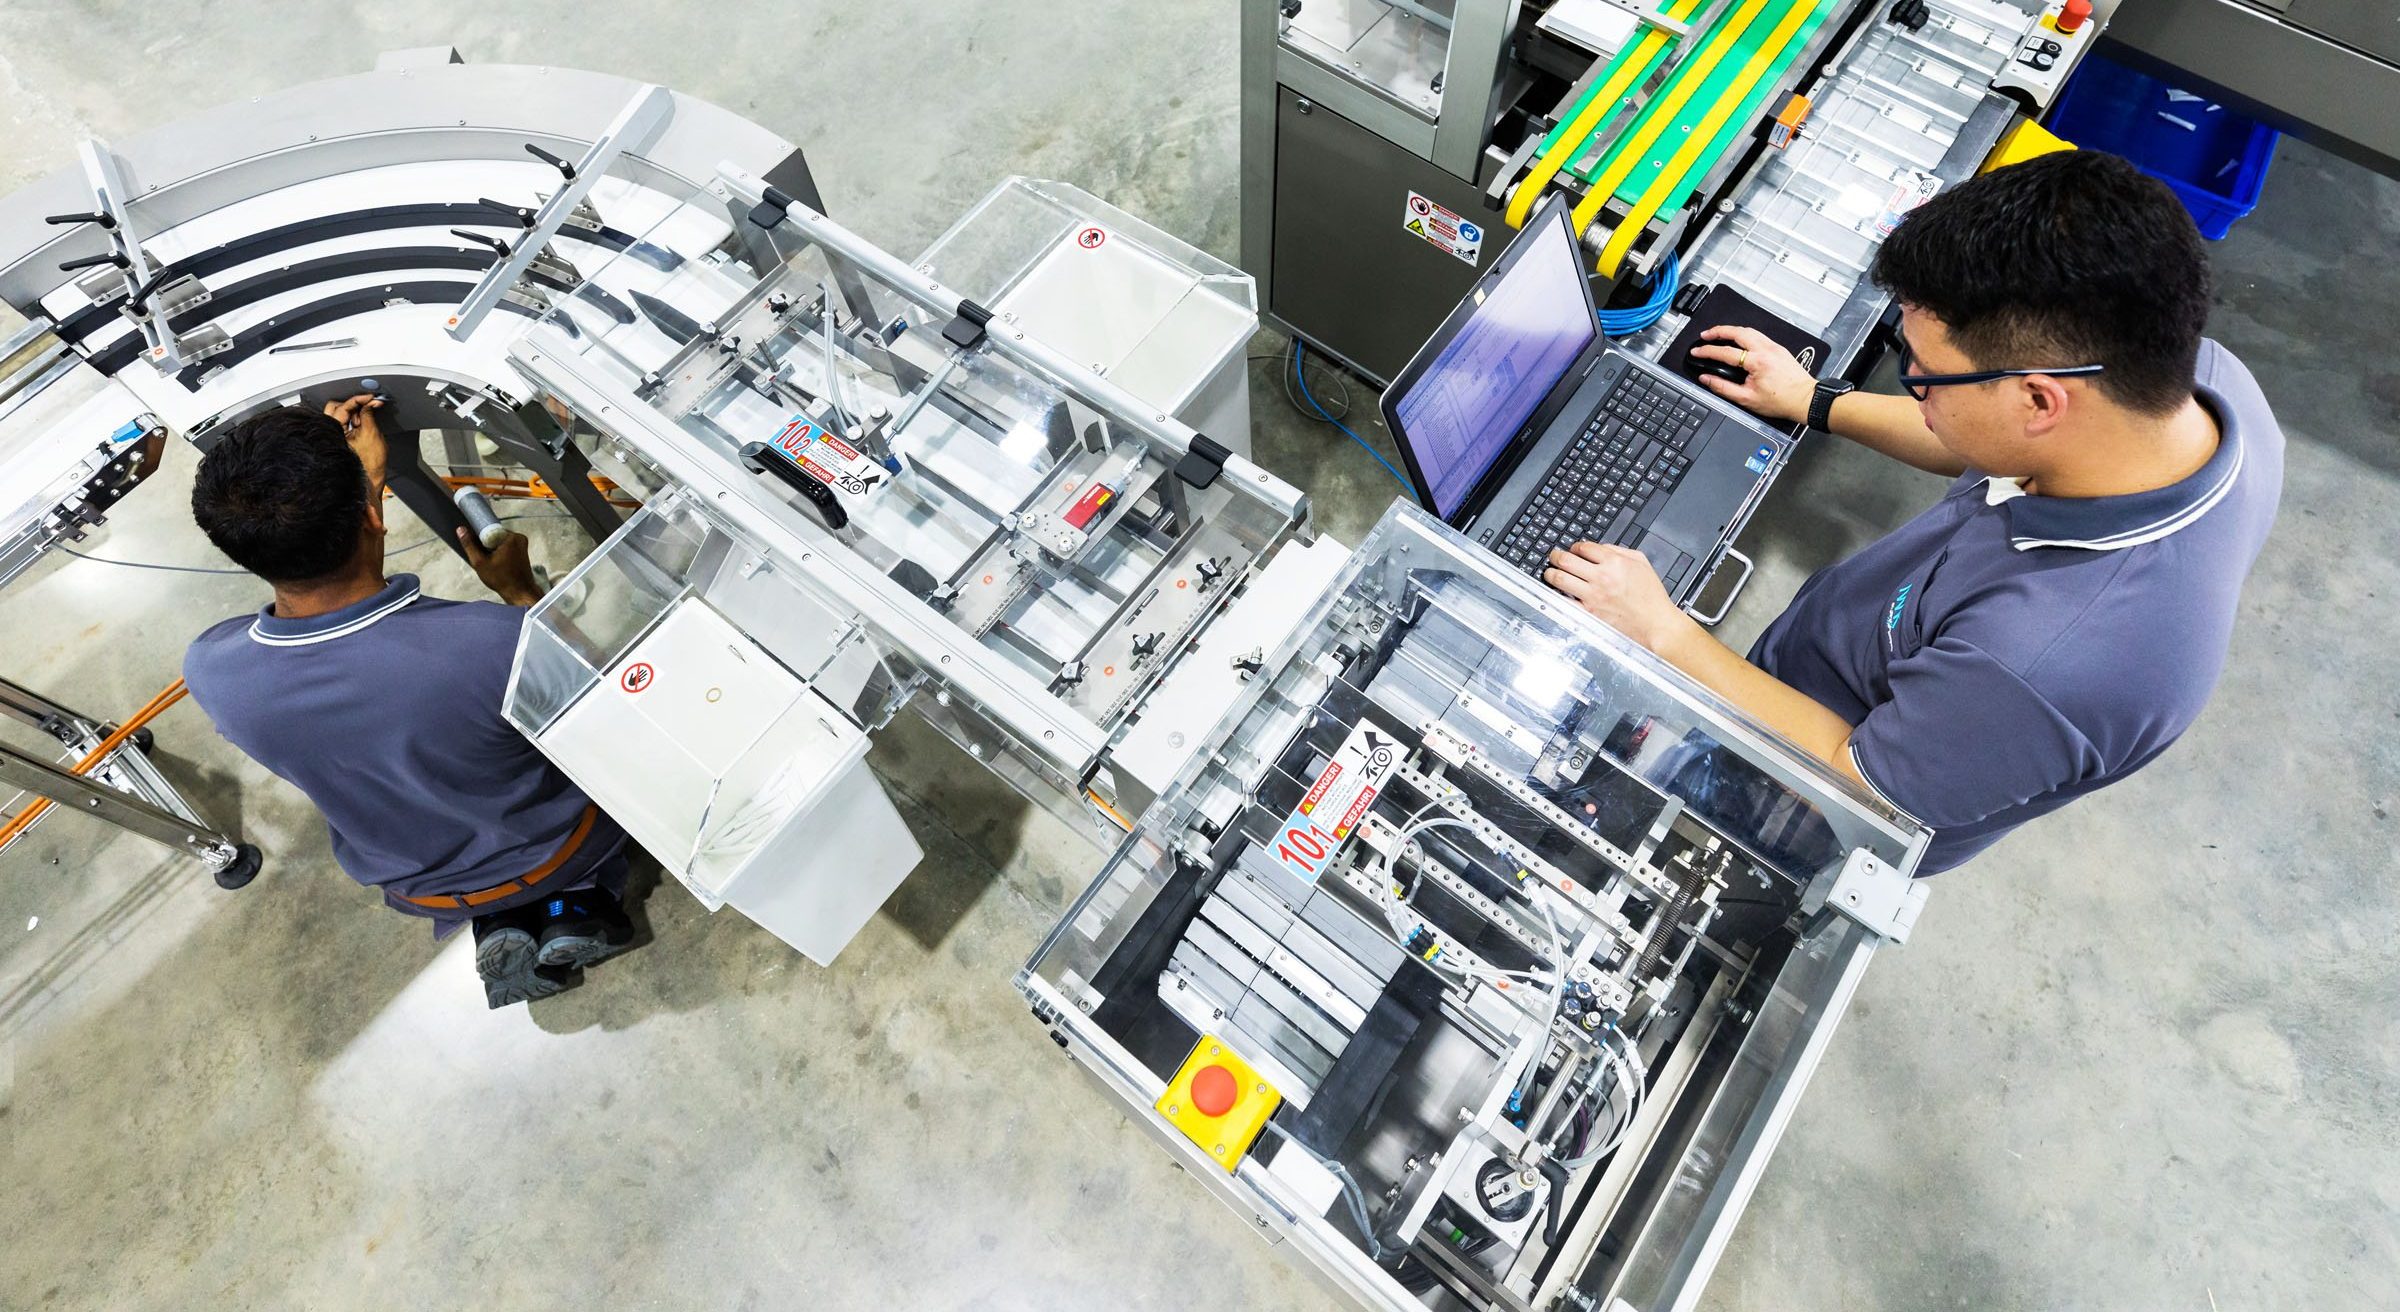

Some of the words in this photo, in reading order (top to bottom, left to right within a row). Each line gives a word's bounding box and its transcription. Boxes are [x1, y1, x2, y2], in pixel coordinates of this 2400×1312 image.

[775, 420, 811, 456] 10.2
[828, 439, 858, 460] DANGER!
[804, 458, 833, 482] GEFAHR!
[1309, 764, 1342, 804] DANGER!
[1343, 788, 1375, 827] GEFAHR!
[1277, 824, 1335, 873] 10.1
